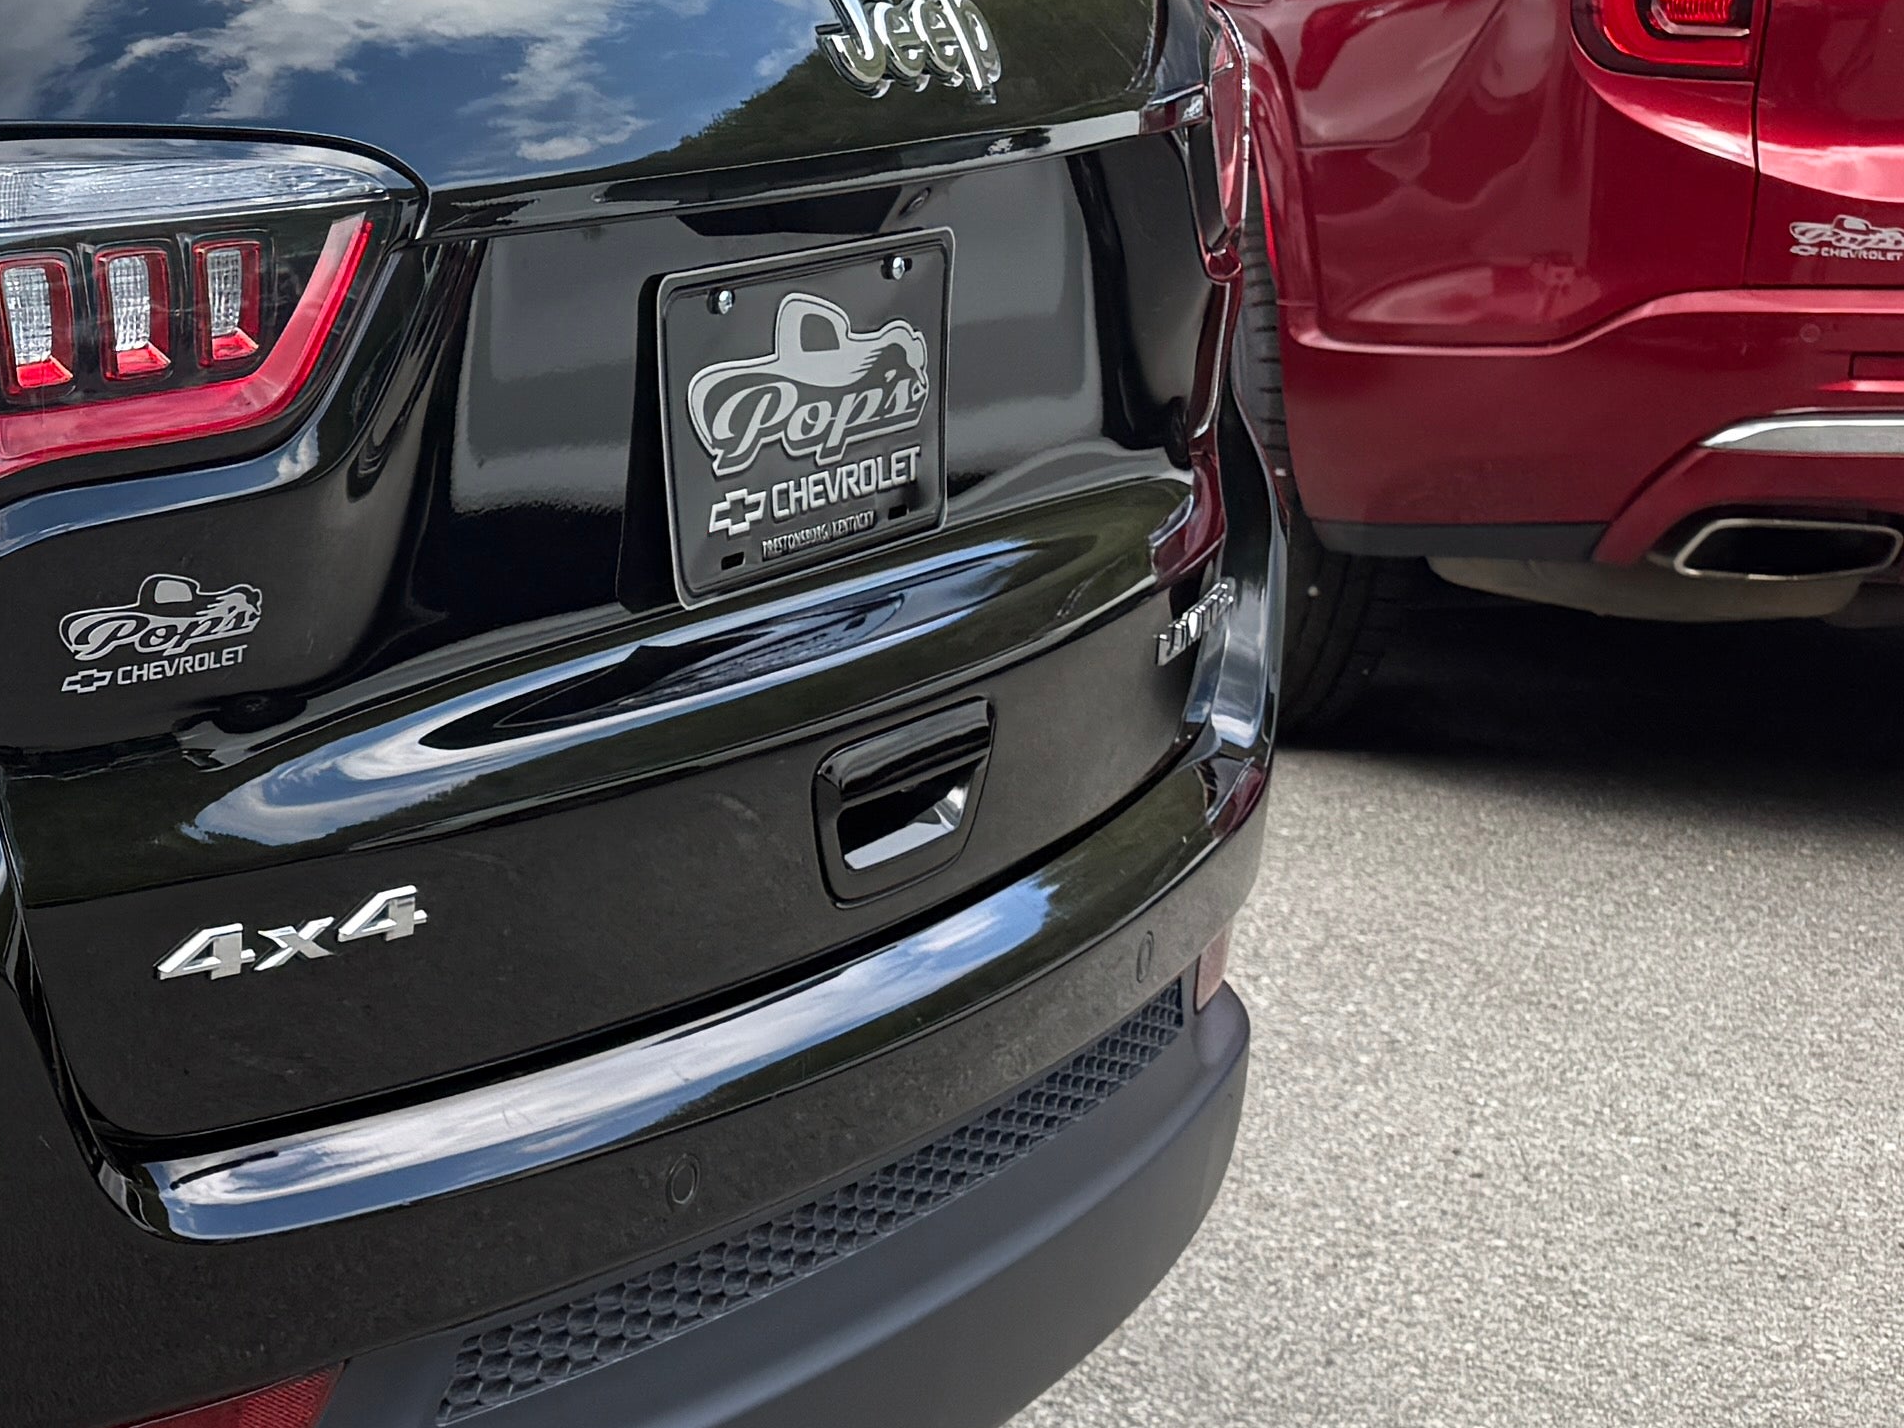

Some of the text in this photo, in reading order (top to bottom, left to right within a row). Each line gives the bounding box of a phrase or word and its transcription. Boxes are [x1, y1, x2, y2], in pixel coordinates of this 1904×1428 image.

[1820, 246, 1904, 262] CHEVROLET
[712, 369, 917, 458] Pop's
[771, 446, 921, 520] CHEVROLET
[74, 605, 251, 657] Pop's
[117, 644, 248, 685] CHEVROLET
[154, 884, 429, 981] 4x4
